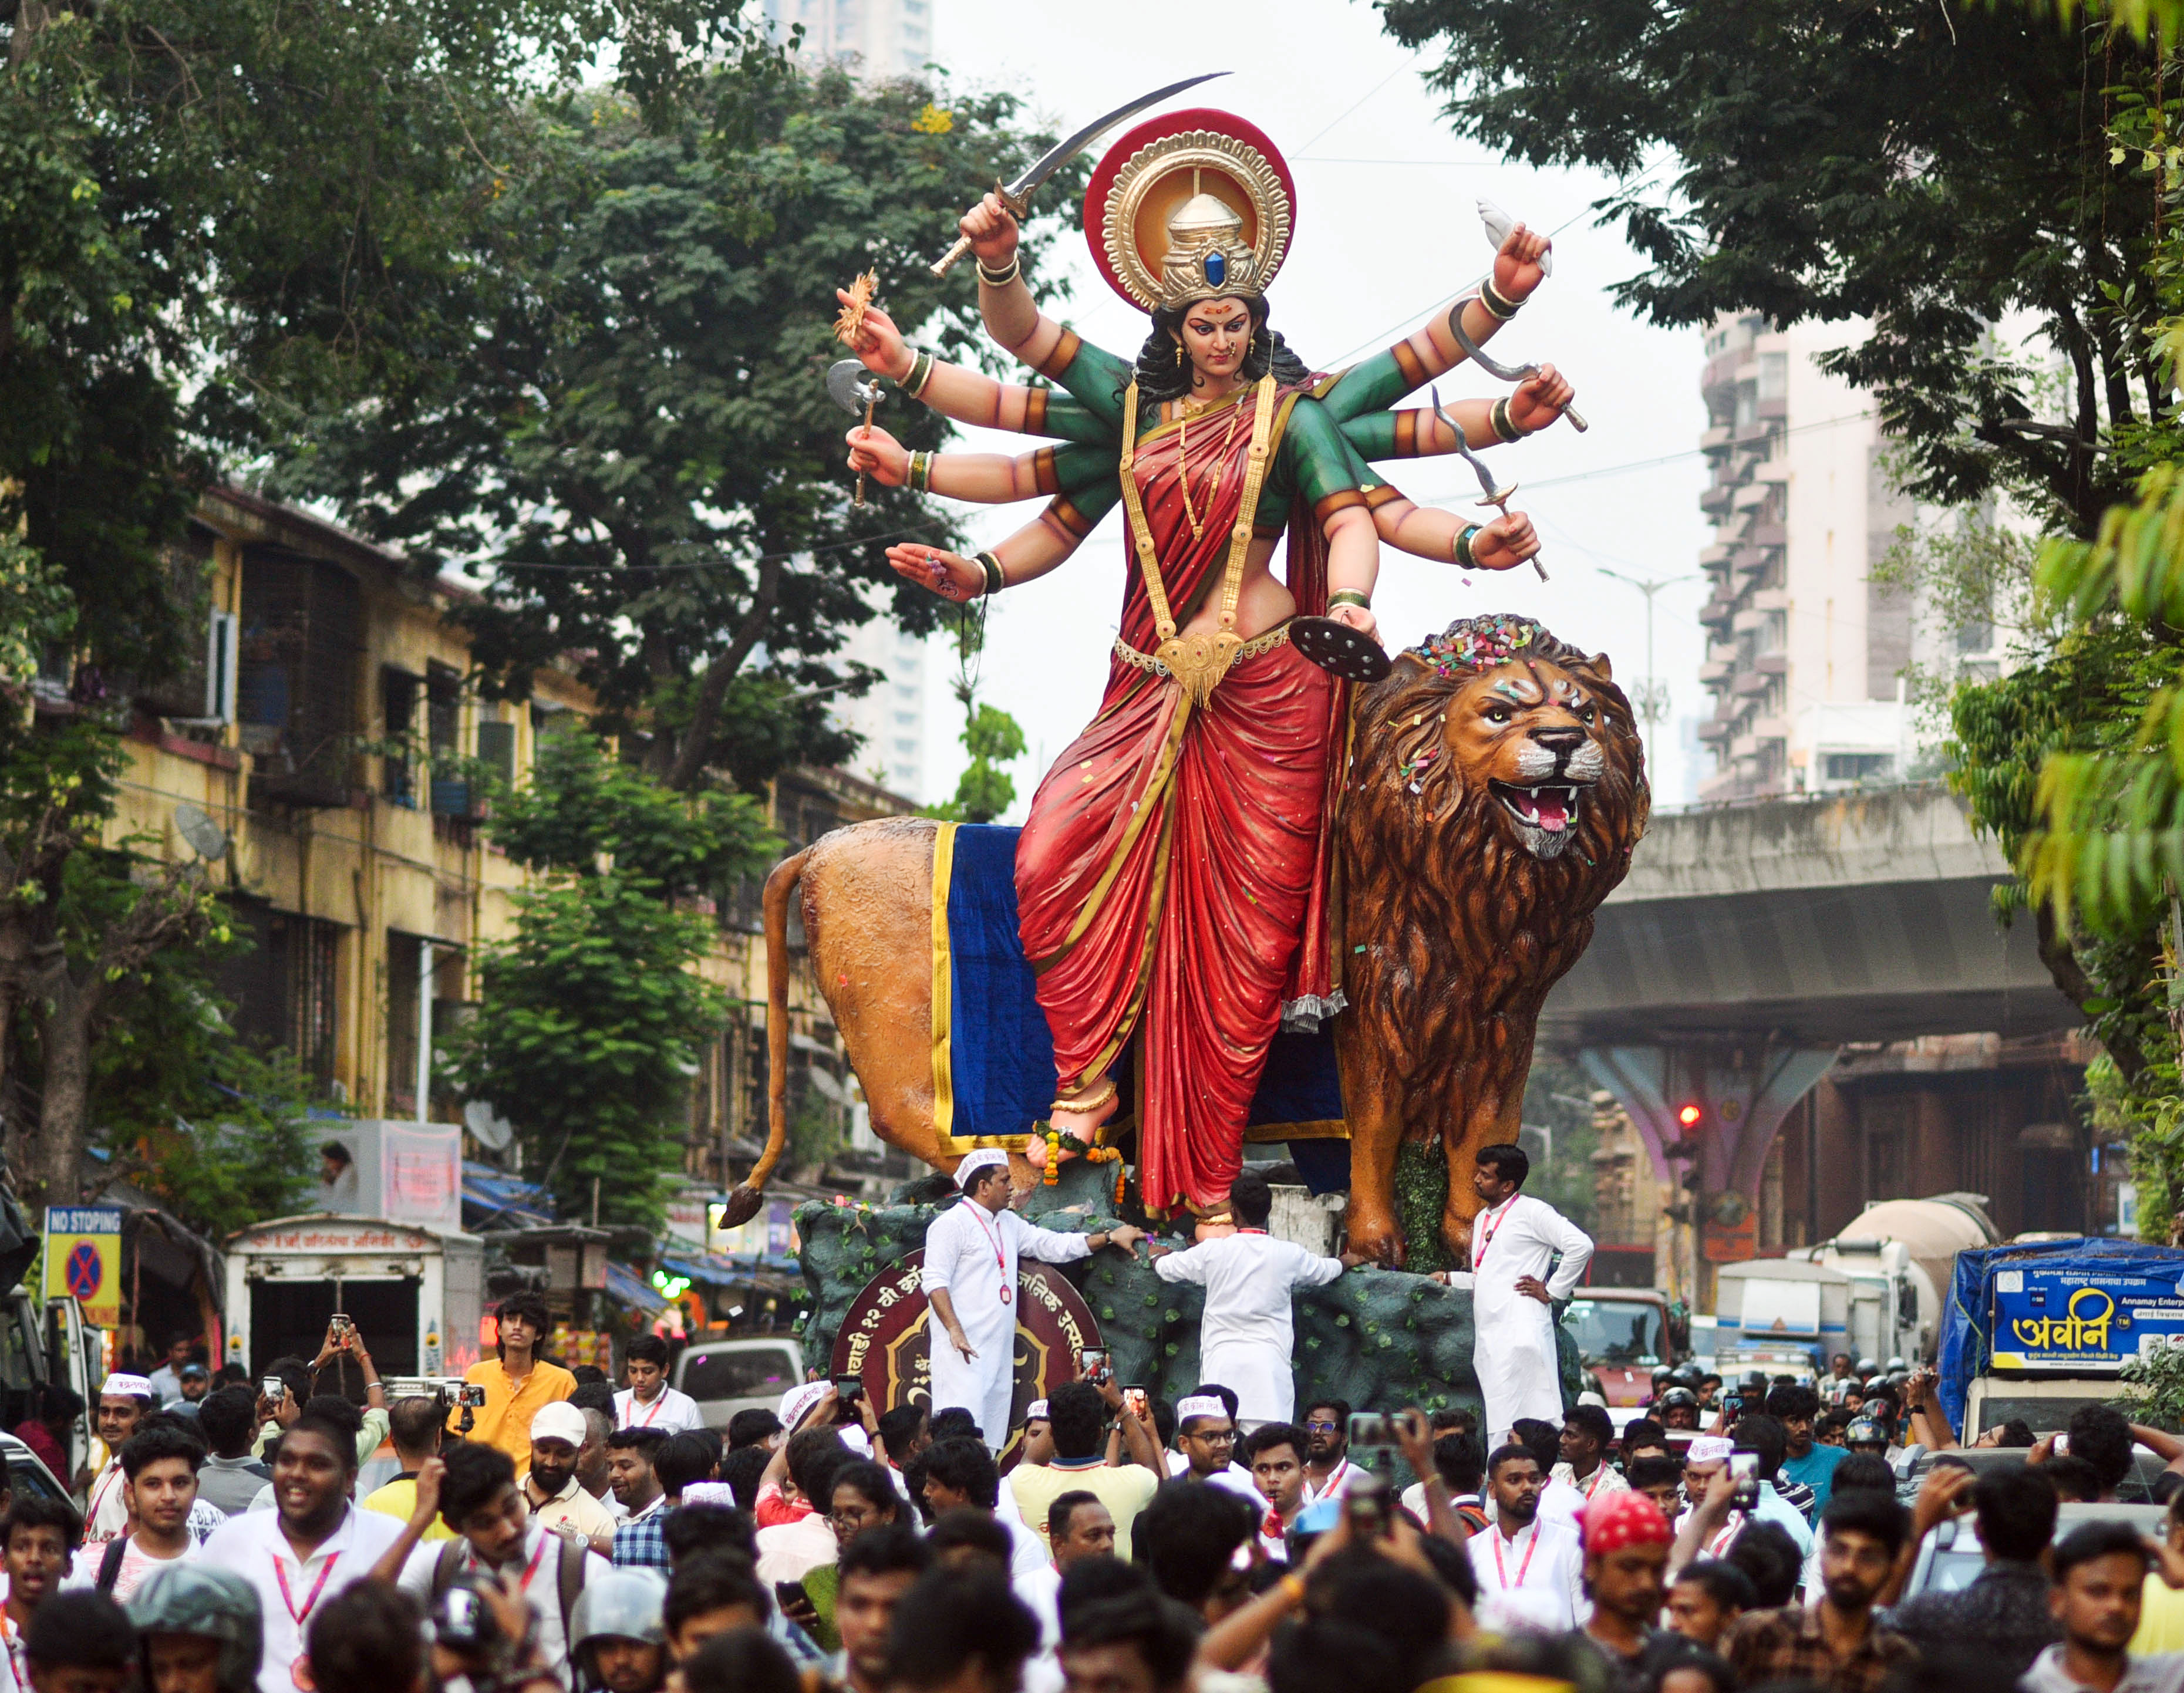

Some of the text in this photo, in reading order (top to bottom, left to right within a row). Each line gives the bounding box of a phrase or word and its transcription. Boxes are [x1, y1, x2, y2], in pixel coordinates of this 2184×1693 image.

[51, 1211, 120, 1232] NO STOPING
[2122, 1297, 2157, 1307] Annamay
